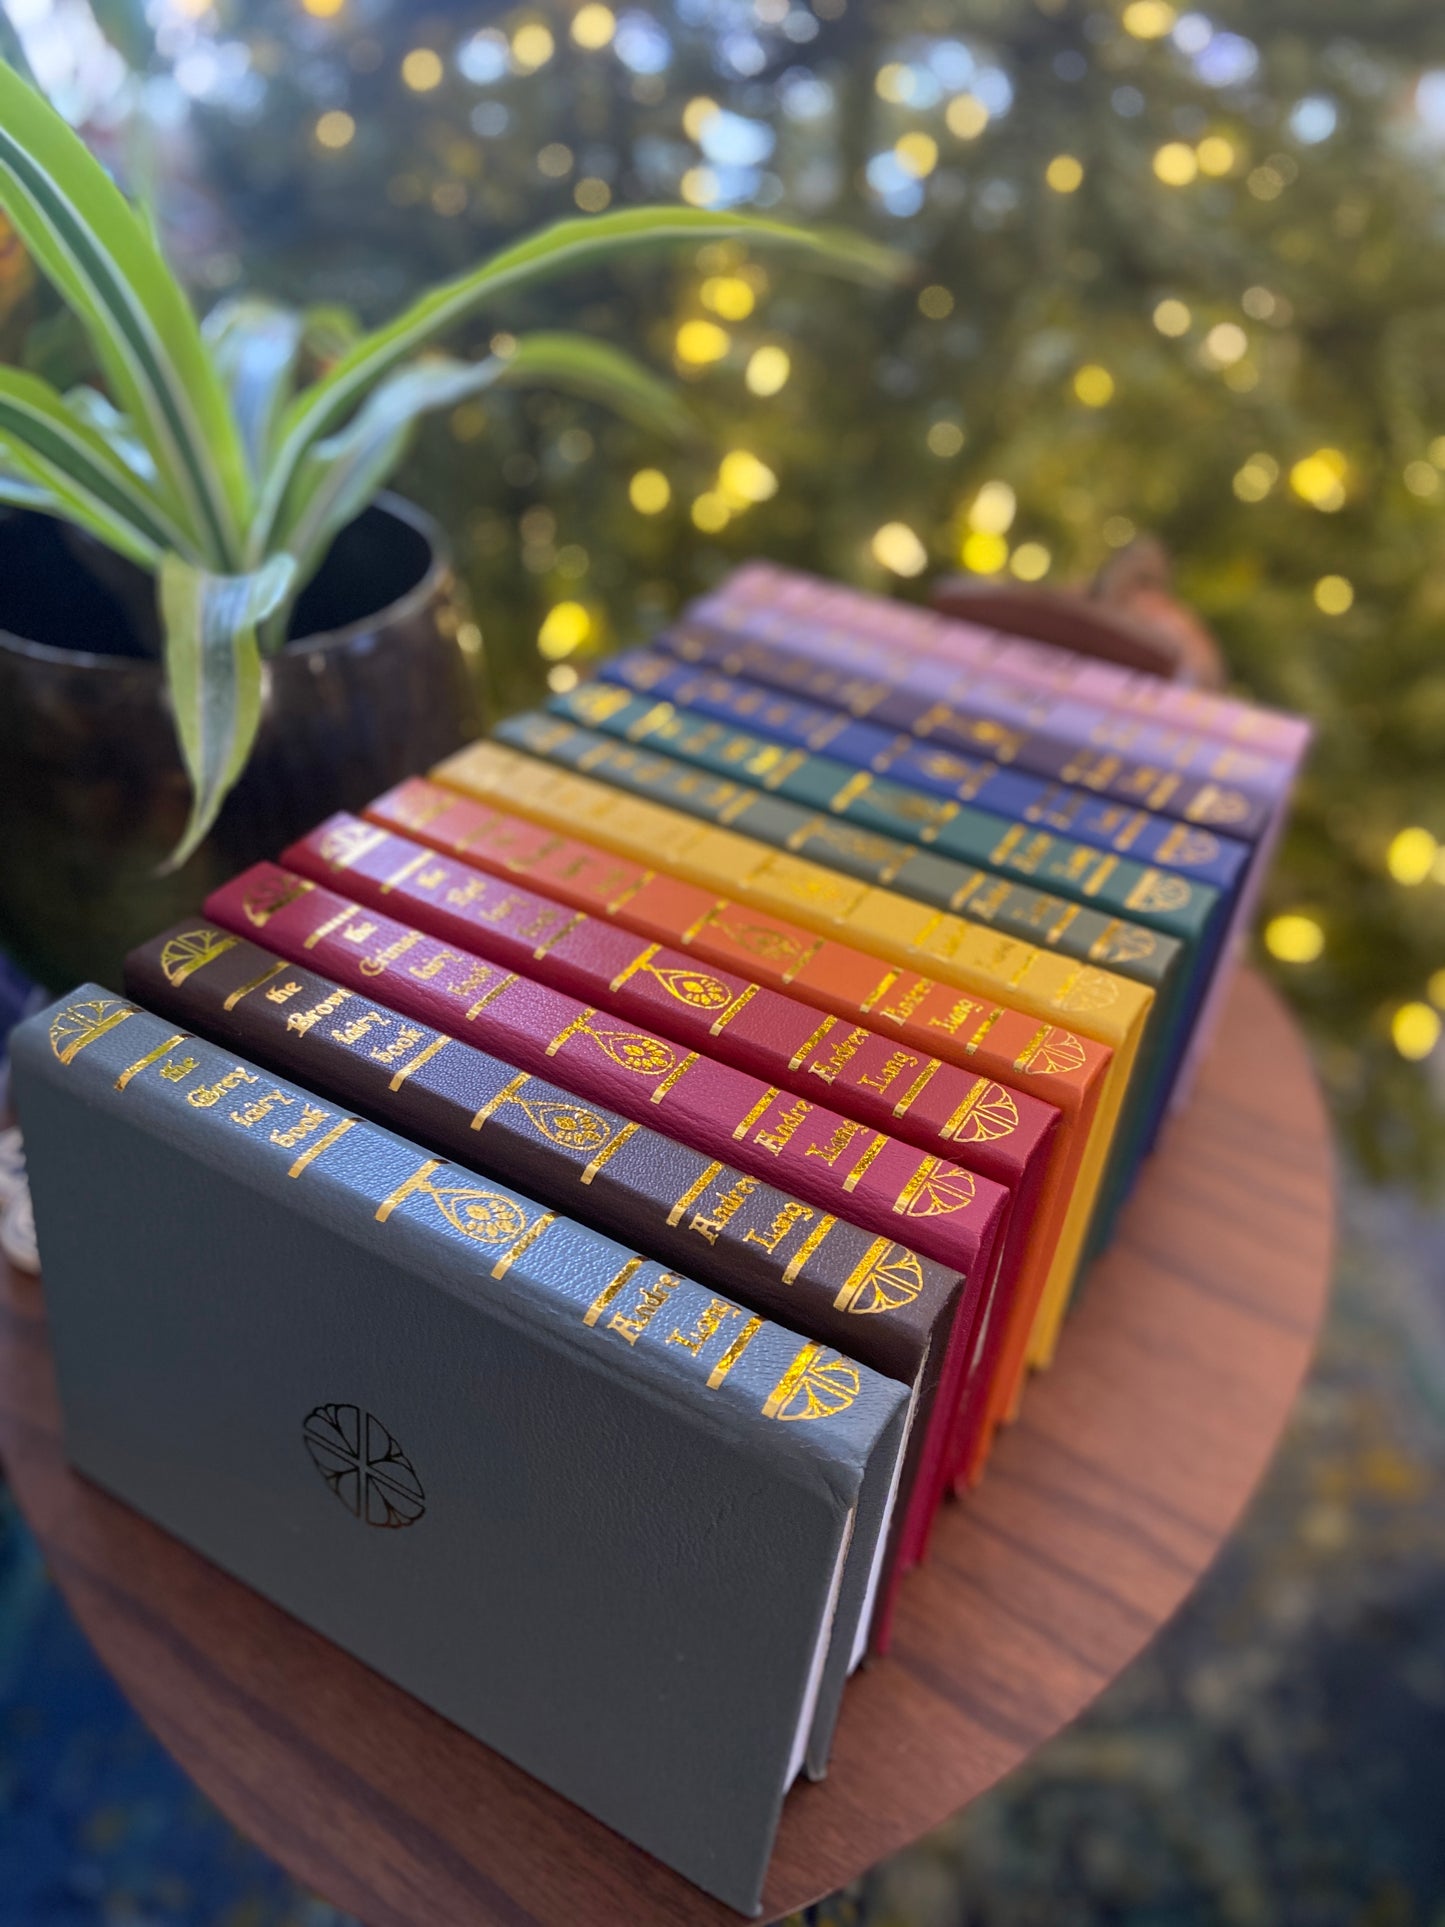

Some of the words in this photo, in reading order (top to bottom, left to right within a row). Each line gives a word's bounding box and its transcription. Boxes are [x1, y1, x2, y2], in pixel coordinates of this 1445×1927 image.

[359, 929, 424, 977] Crimso
[409, 949, 464, 980] fairy
[265, 981, 303, 1004] the
[331, 1011, 392, 1045] fairy
[370, 1024, 425, 1063] book
[159, 1056, 201, 1083] the
[186, 1066, 259, 1107] Grey
[856, 1051, 918, 1095] Lang
[229, 1089, 296, 1128] fairy
[269, 1103, 330, 1148] book
[753, 1100, 814, 1157] Andre
[804, 1119, 870, 1167] Lang
[742, 1201, 814, 1255] Lang
[665, 1298, 743, 1358] Lang
